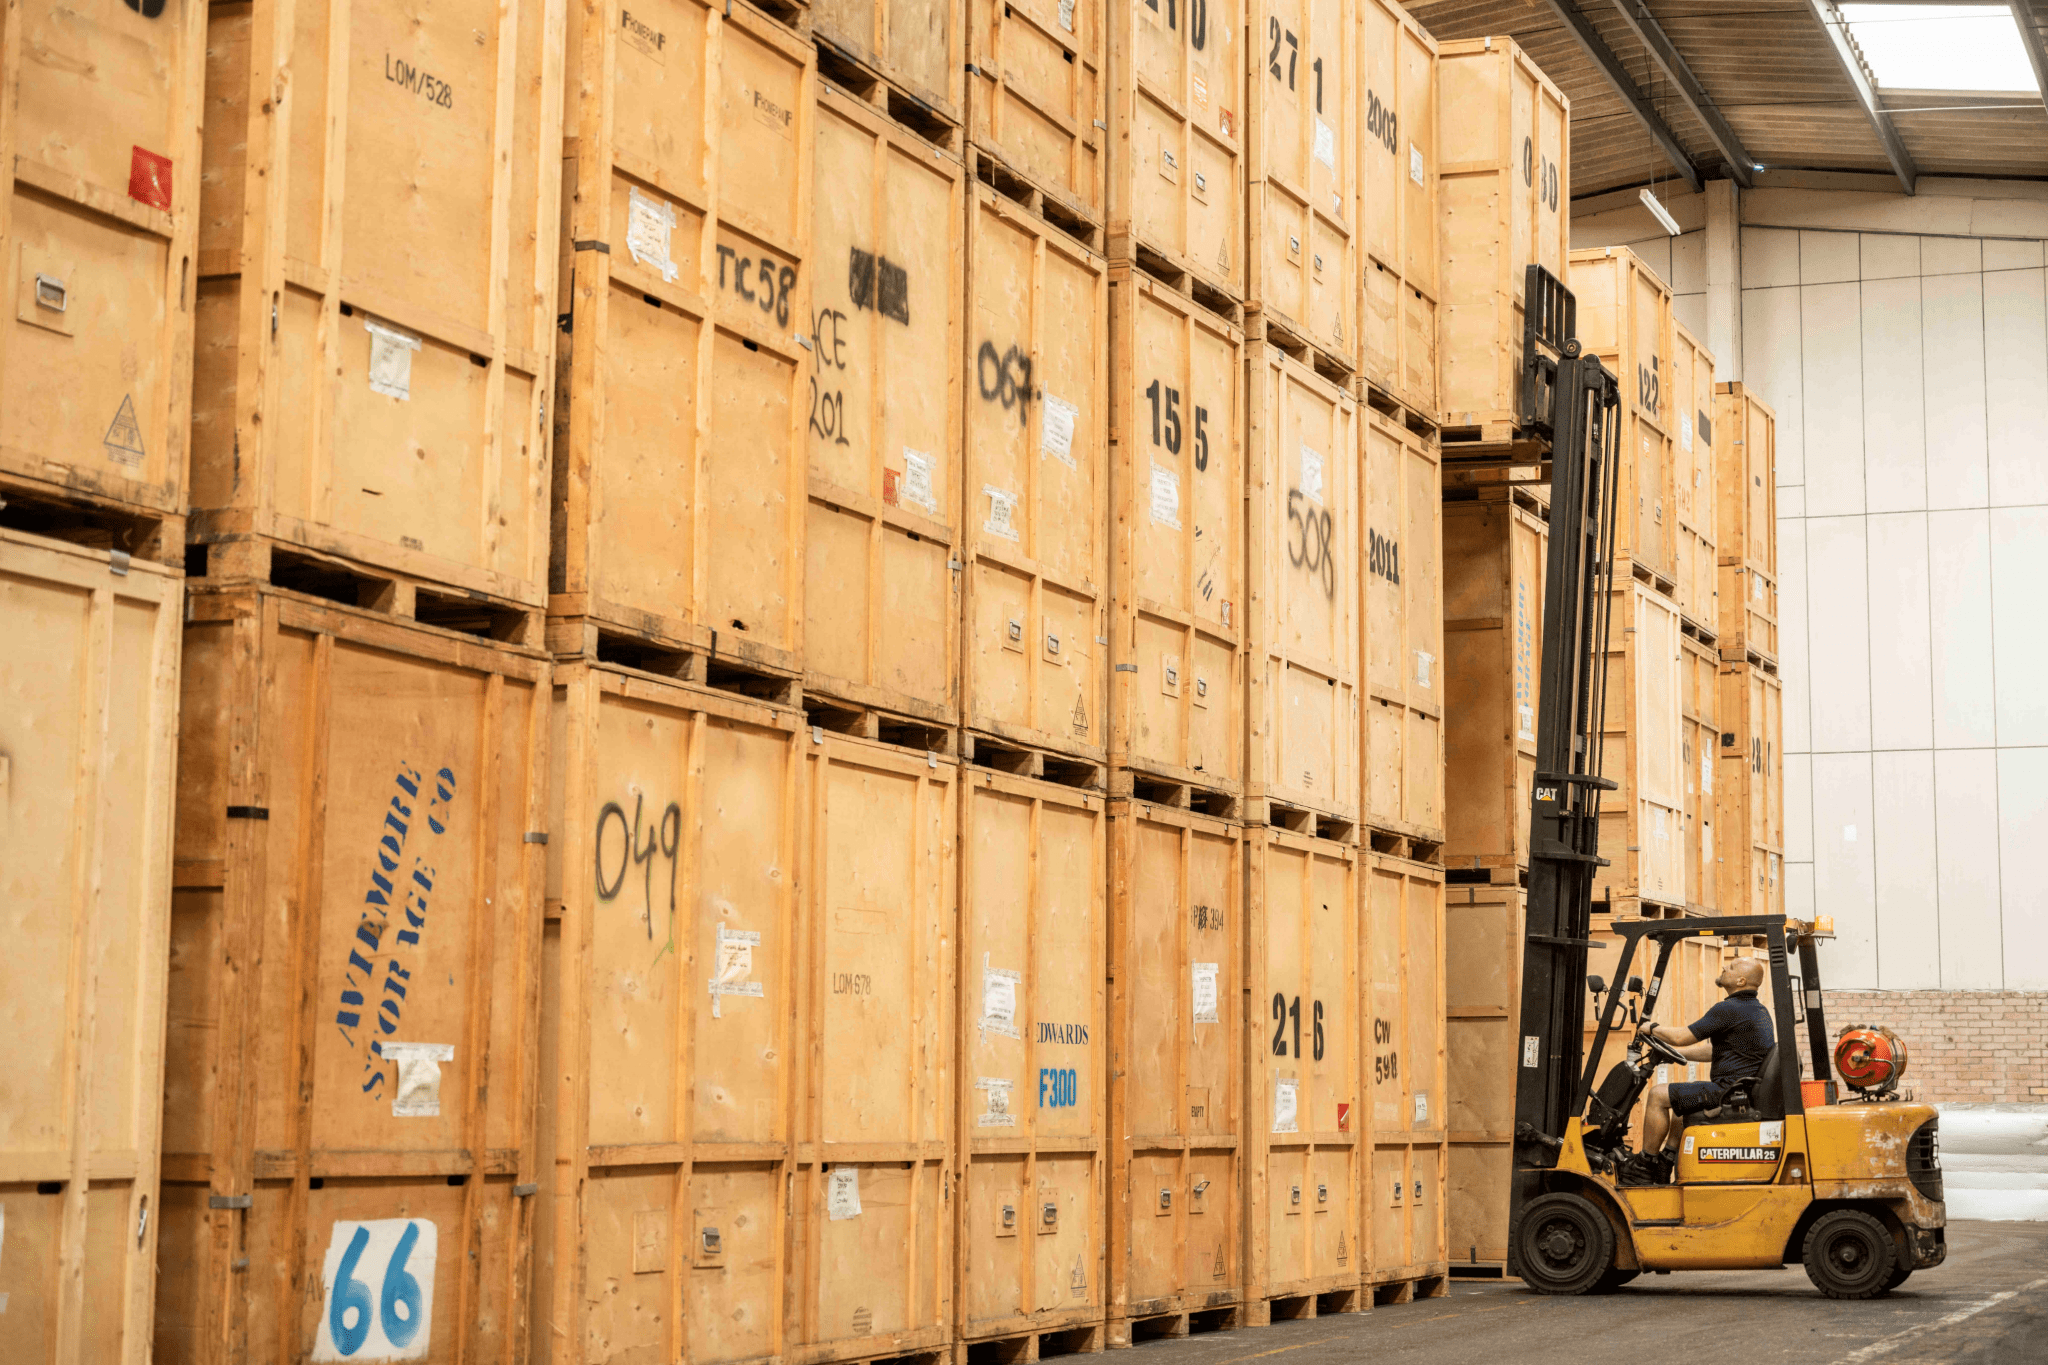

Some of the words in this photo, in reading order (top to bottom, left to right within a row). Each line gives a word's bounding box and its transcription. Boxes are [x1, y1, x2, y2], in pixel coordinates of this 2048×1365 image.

[385, 52, 453, 110] LOM/528
[1367, 88, 1398, 156] 2003
[1288, 487, 1334, 601] 508
[1369, 526, 1400, 585] 2011
[1535, 787, 1558, 801] CAT
[595, 793, 681, 941] 049
[1374, 1017, 1391, 1045] CW
[1039, 1068, 1078, 1109] F300
[1375, 1051, 1398, 1086] 598
[1700, 1148, 1764, 1161] CATERPILLAR
[1763, 1150, 1776, 1161] 25
[329, 1220, 423, 1357] 66
